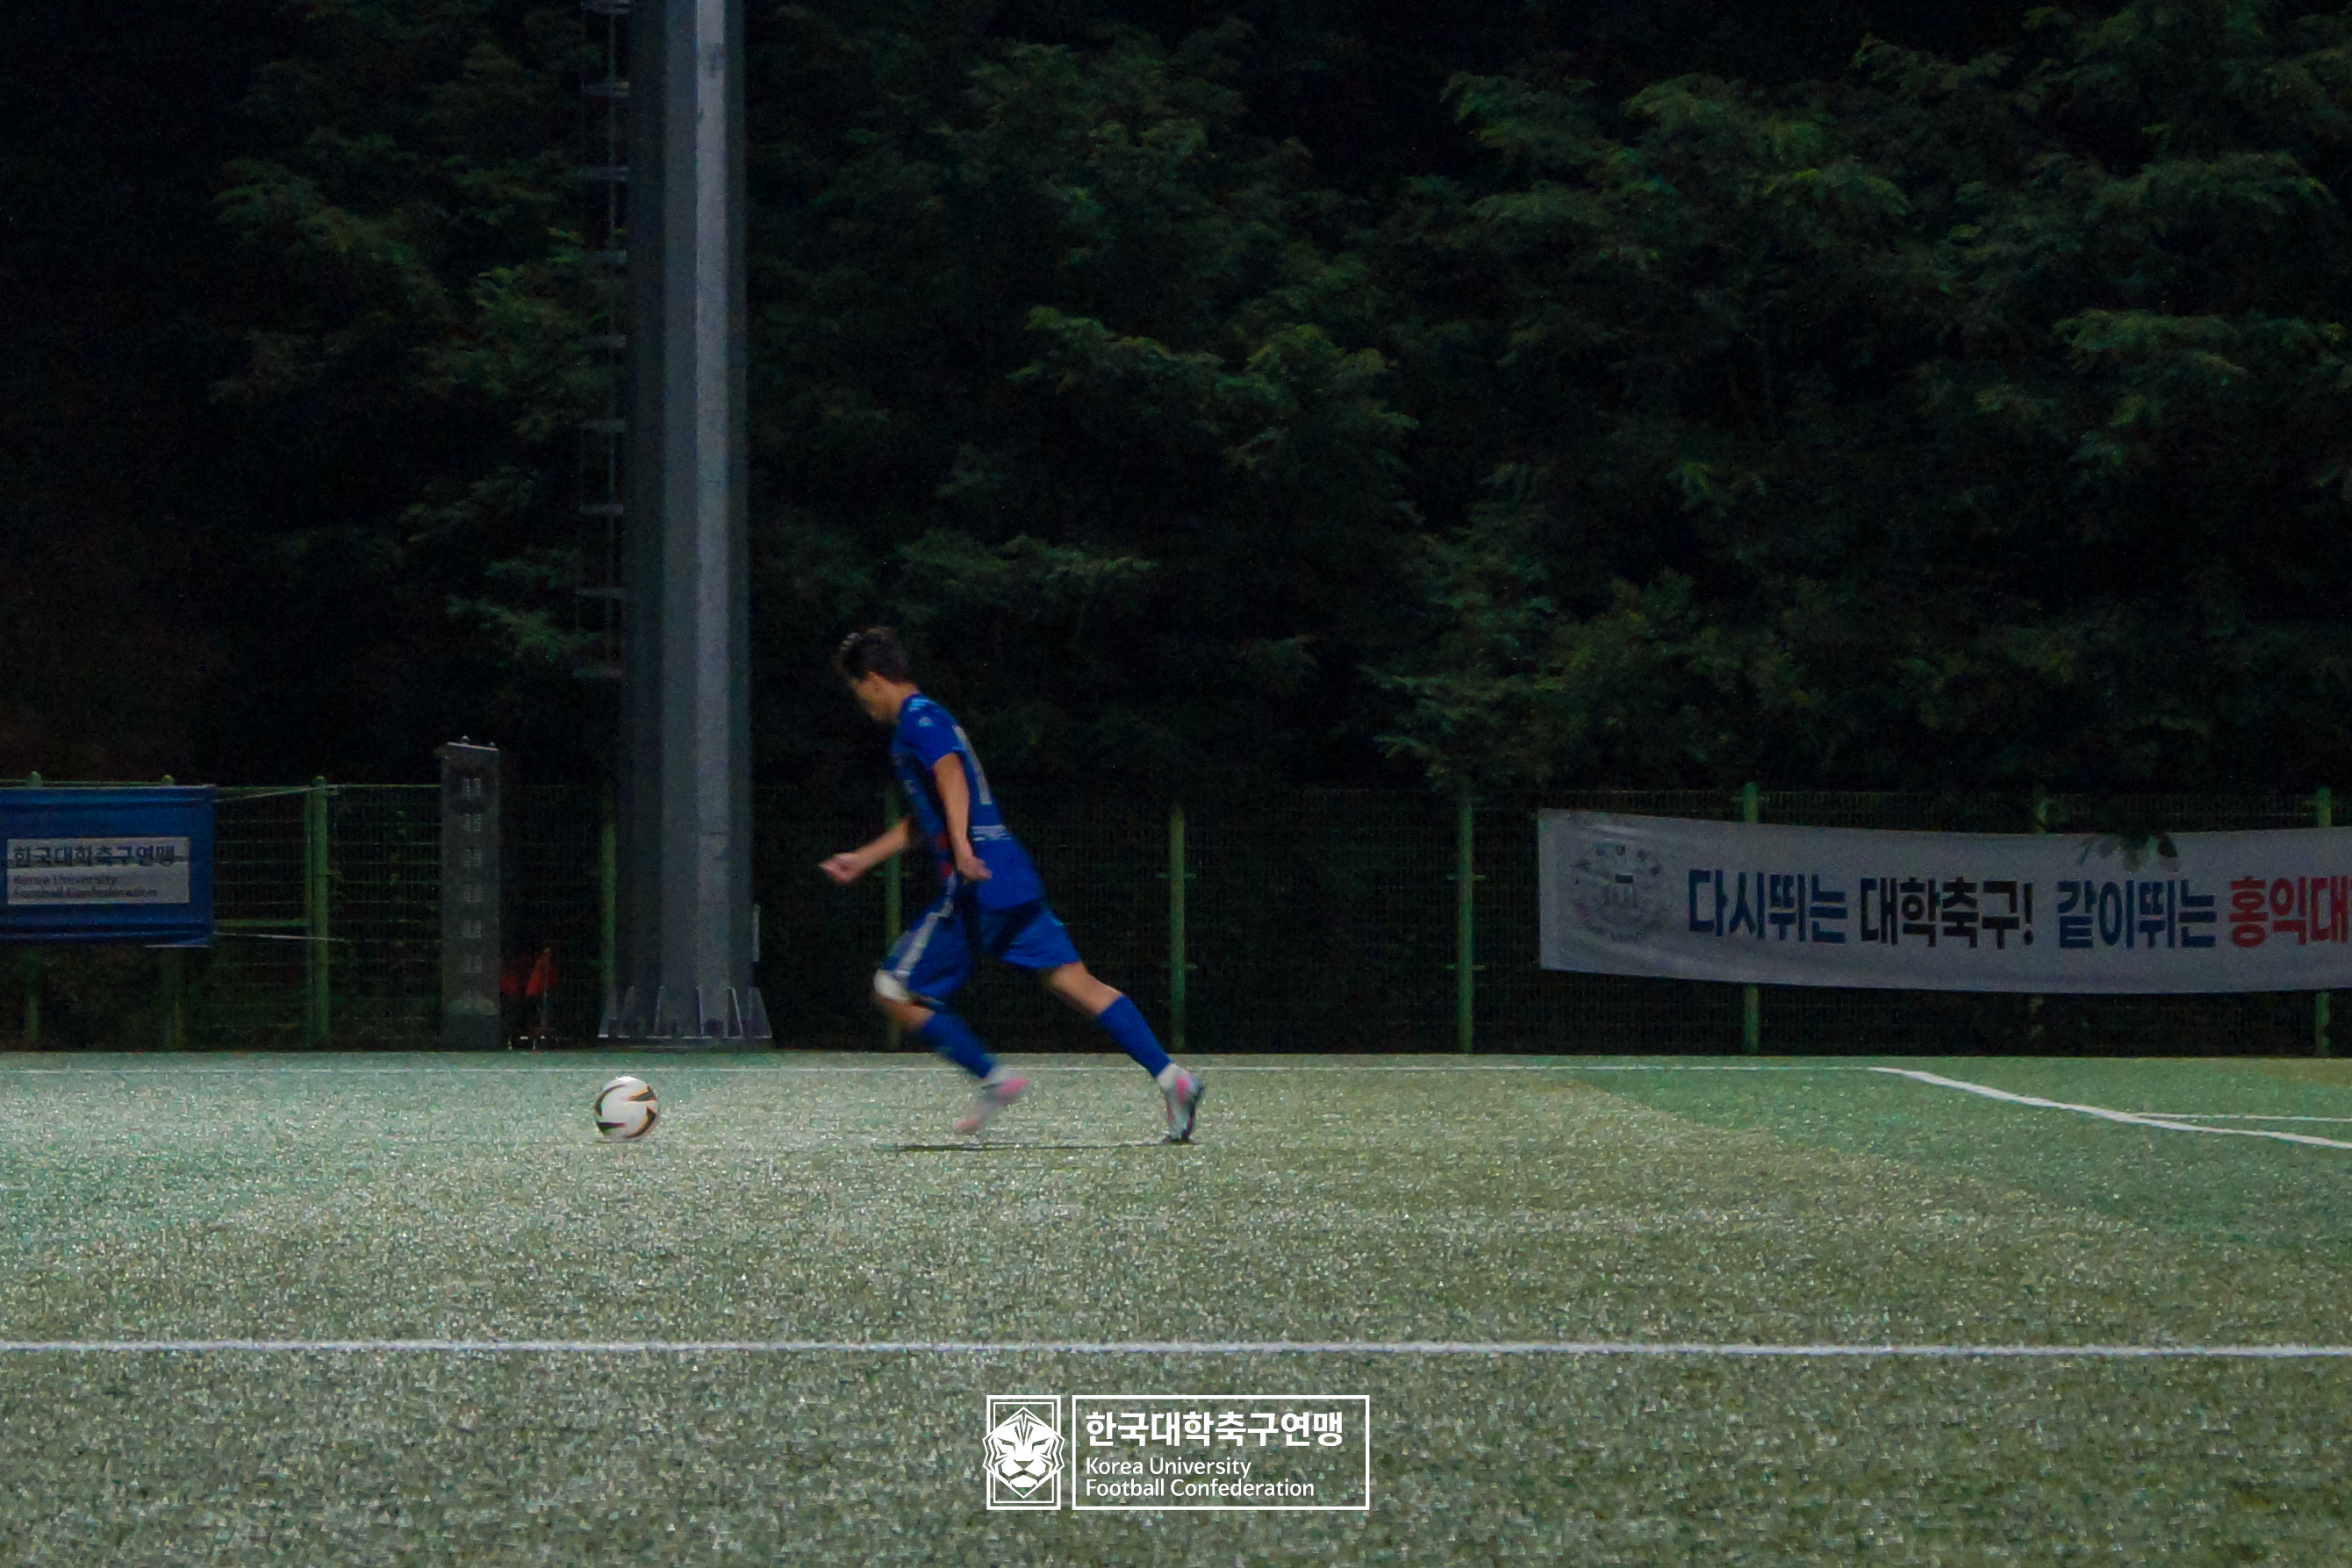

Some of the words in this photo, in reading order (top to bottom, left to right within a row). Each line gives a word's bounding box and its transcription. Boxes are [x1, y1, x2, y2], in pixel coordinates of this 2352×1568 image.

[12, 845, 176, 867] 한국대학축구연맹
[1689, 869, 1847, 943] 다시뛰는
[1861, 876, 2034, 949] 대학축구!
[2057, 878, 2217, 949] 같이뛰는
[2229, 876, 2352, 948] 홍익대
